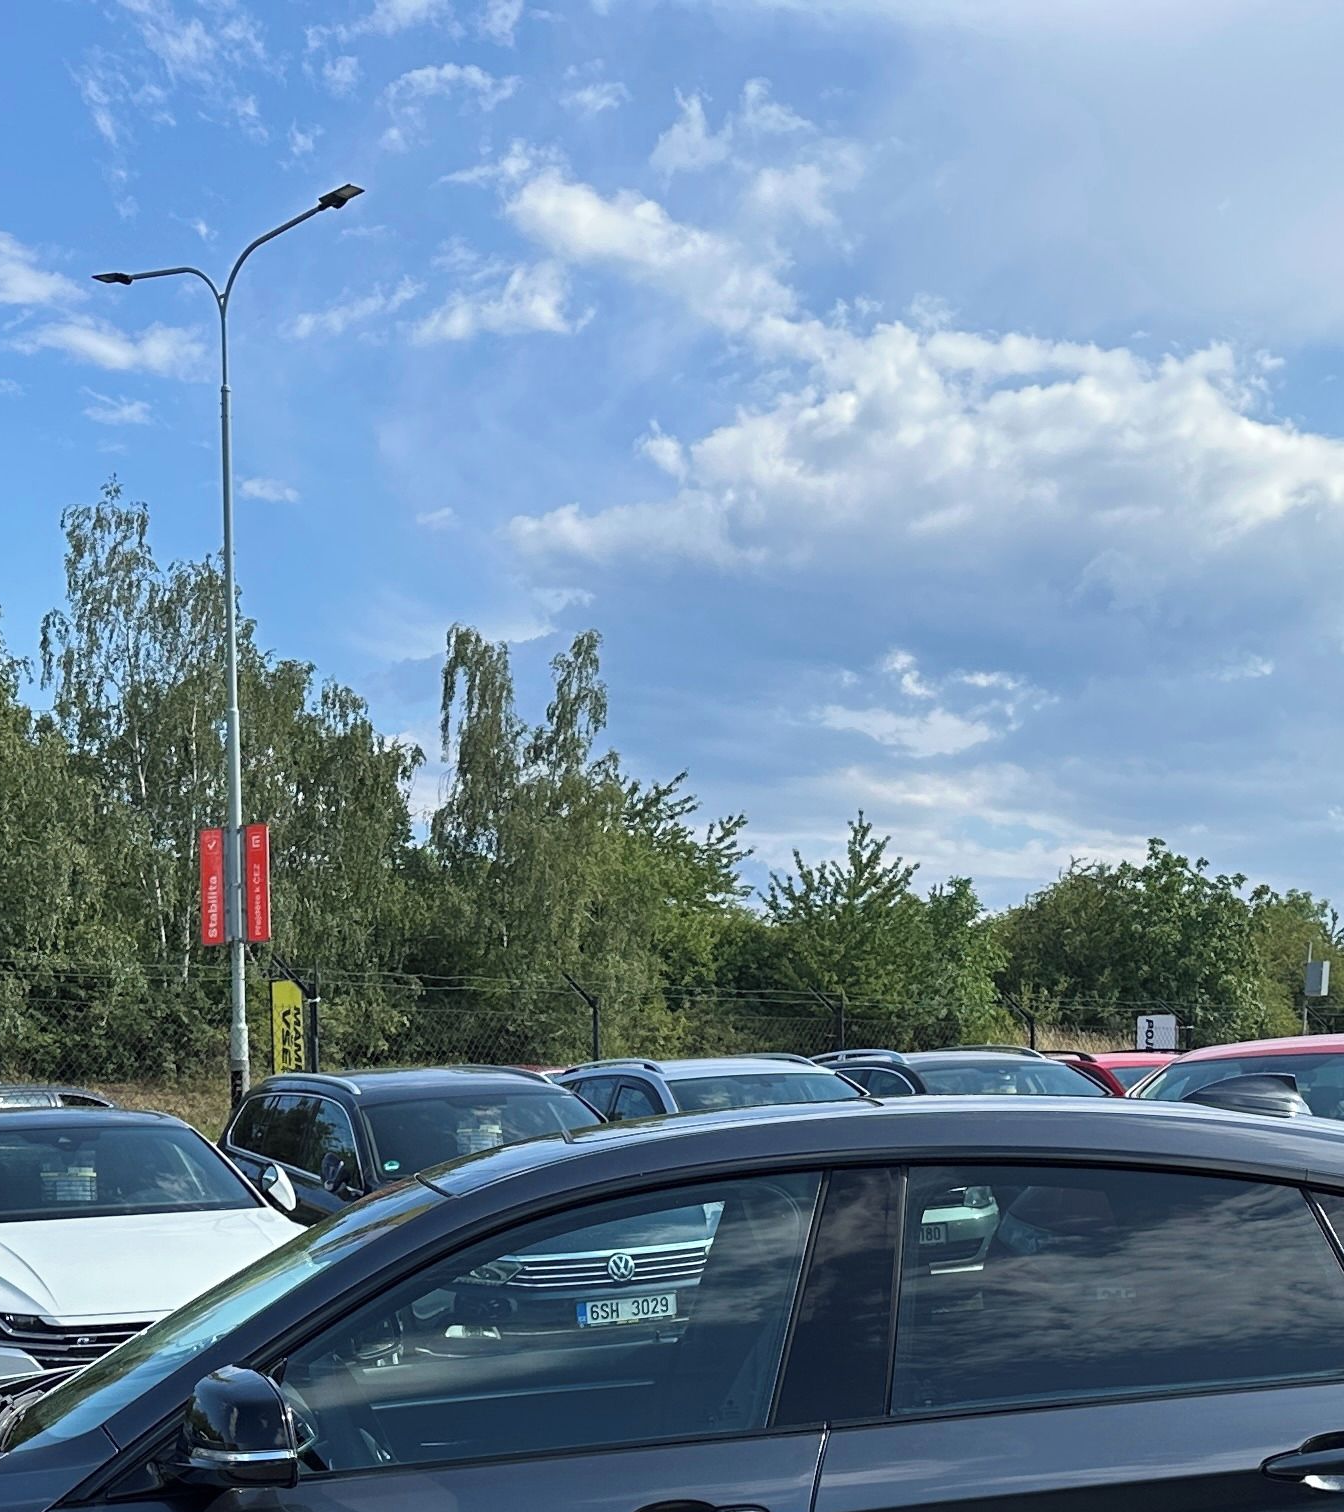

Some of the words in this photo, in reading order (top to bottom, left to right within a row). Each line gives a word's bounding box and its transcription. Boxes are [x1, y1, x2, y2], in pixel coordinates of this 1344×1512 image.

[207, 876, 218, 938] Stabilita
[590, 1303, 620, 1321] 6SH
[632, 1296, 669, 1317] 3029
